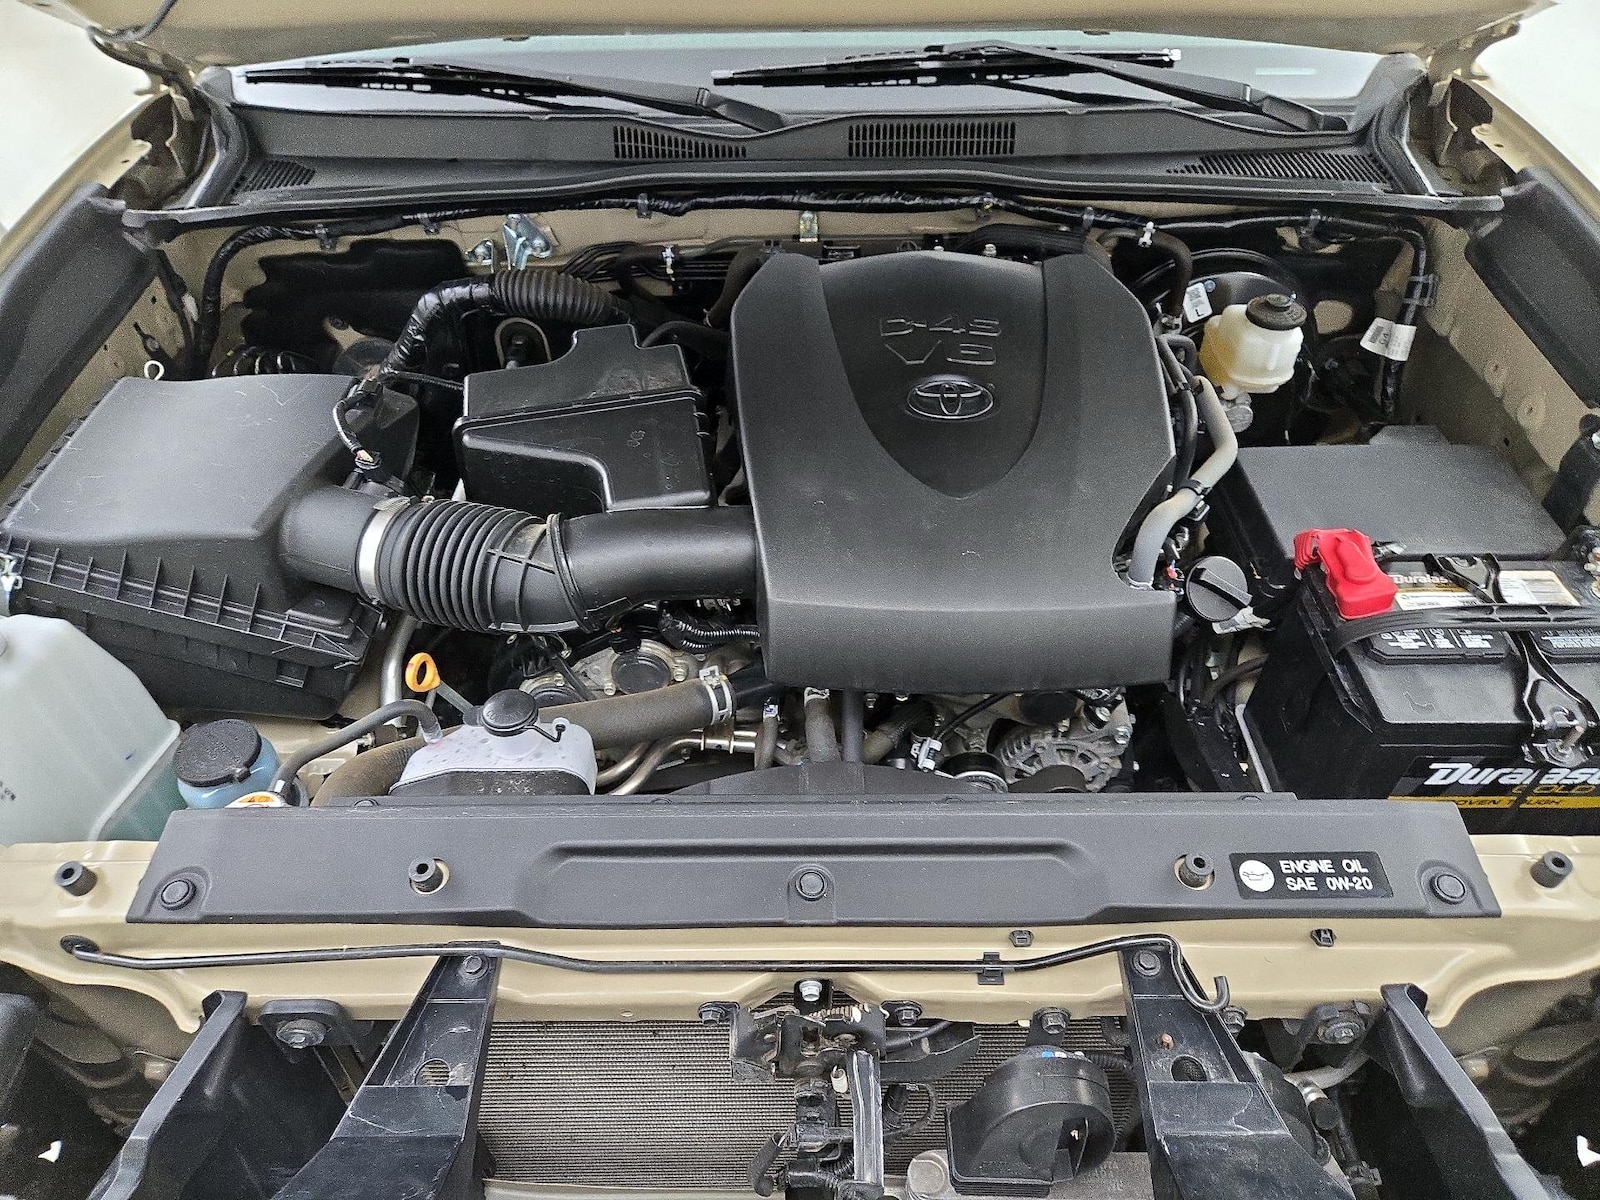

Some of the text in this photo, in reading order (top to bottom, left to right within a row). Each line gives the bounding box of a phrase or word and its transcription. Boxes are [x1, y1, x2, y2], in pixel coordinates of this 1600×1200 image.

[882, 339, 998, 366] V6
[1389, 573, 1454, 584] Duralas
[1278, 859, 1369, 874] ENGINE OIL
[1285, 876, 1374, 891] SAE 0W-20
